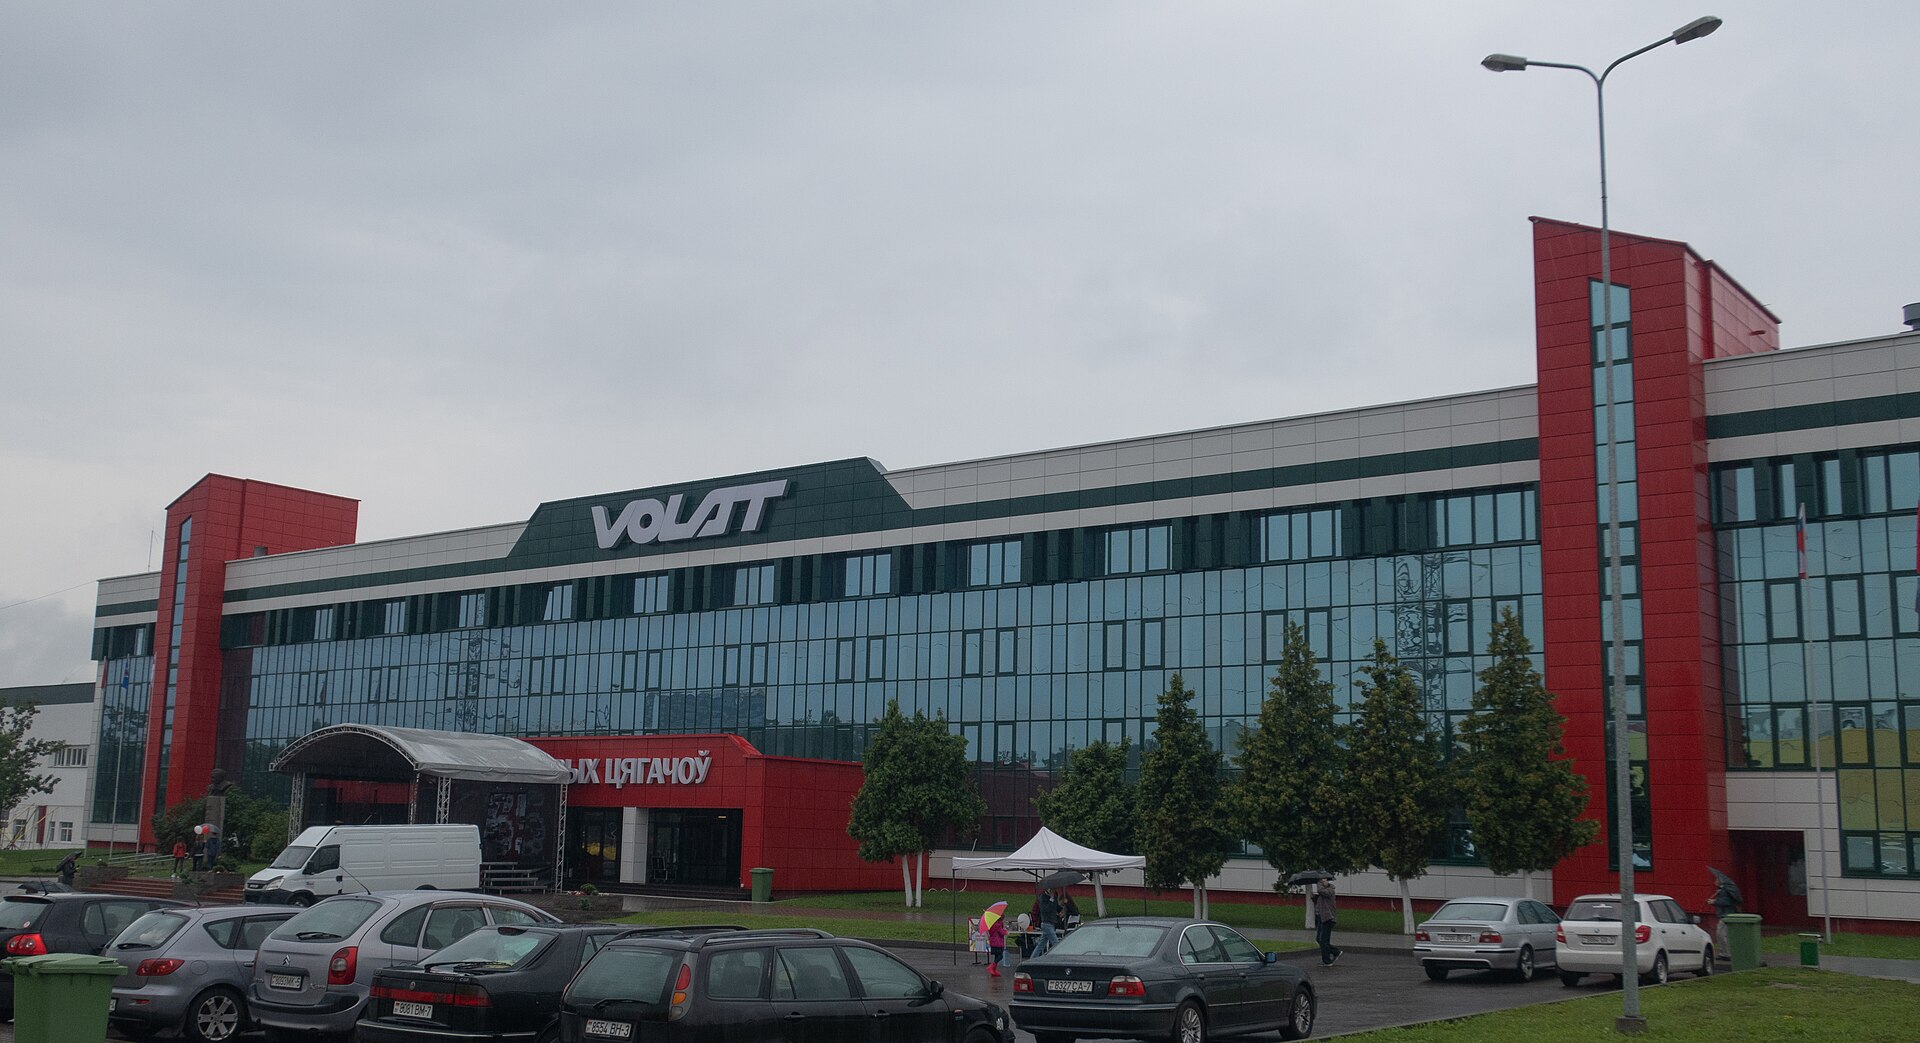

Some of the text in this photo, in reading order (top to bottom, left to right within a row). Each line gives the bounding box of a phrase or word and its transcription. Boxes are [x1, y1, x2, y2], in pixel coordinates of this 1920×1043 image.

[591, 479, 790, 549] VOLAT
[605, 750, 712, 789] ЦЯГАЧОЎ
[1054, 981, 1092, 991] 8327 CA-7
[609, 1022, 630, 1037] BH-3
